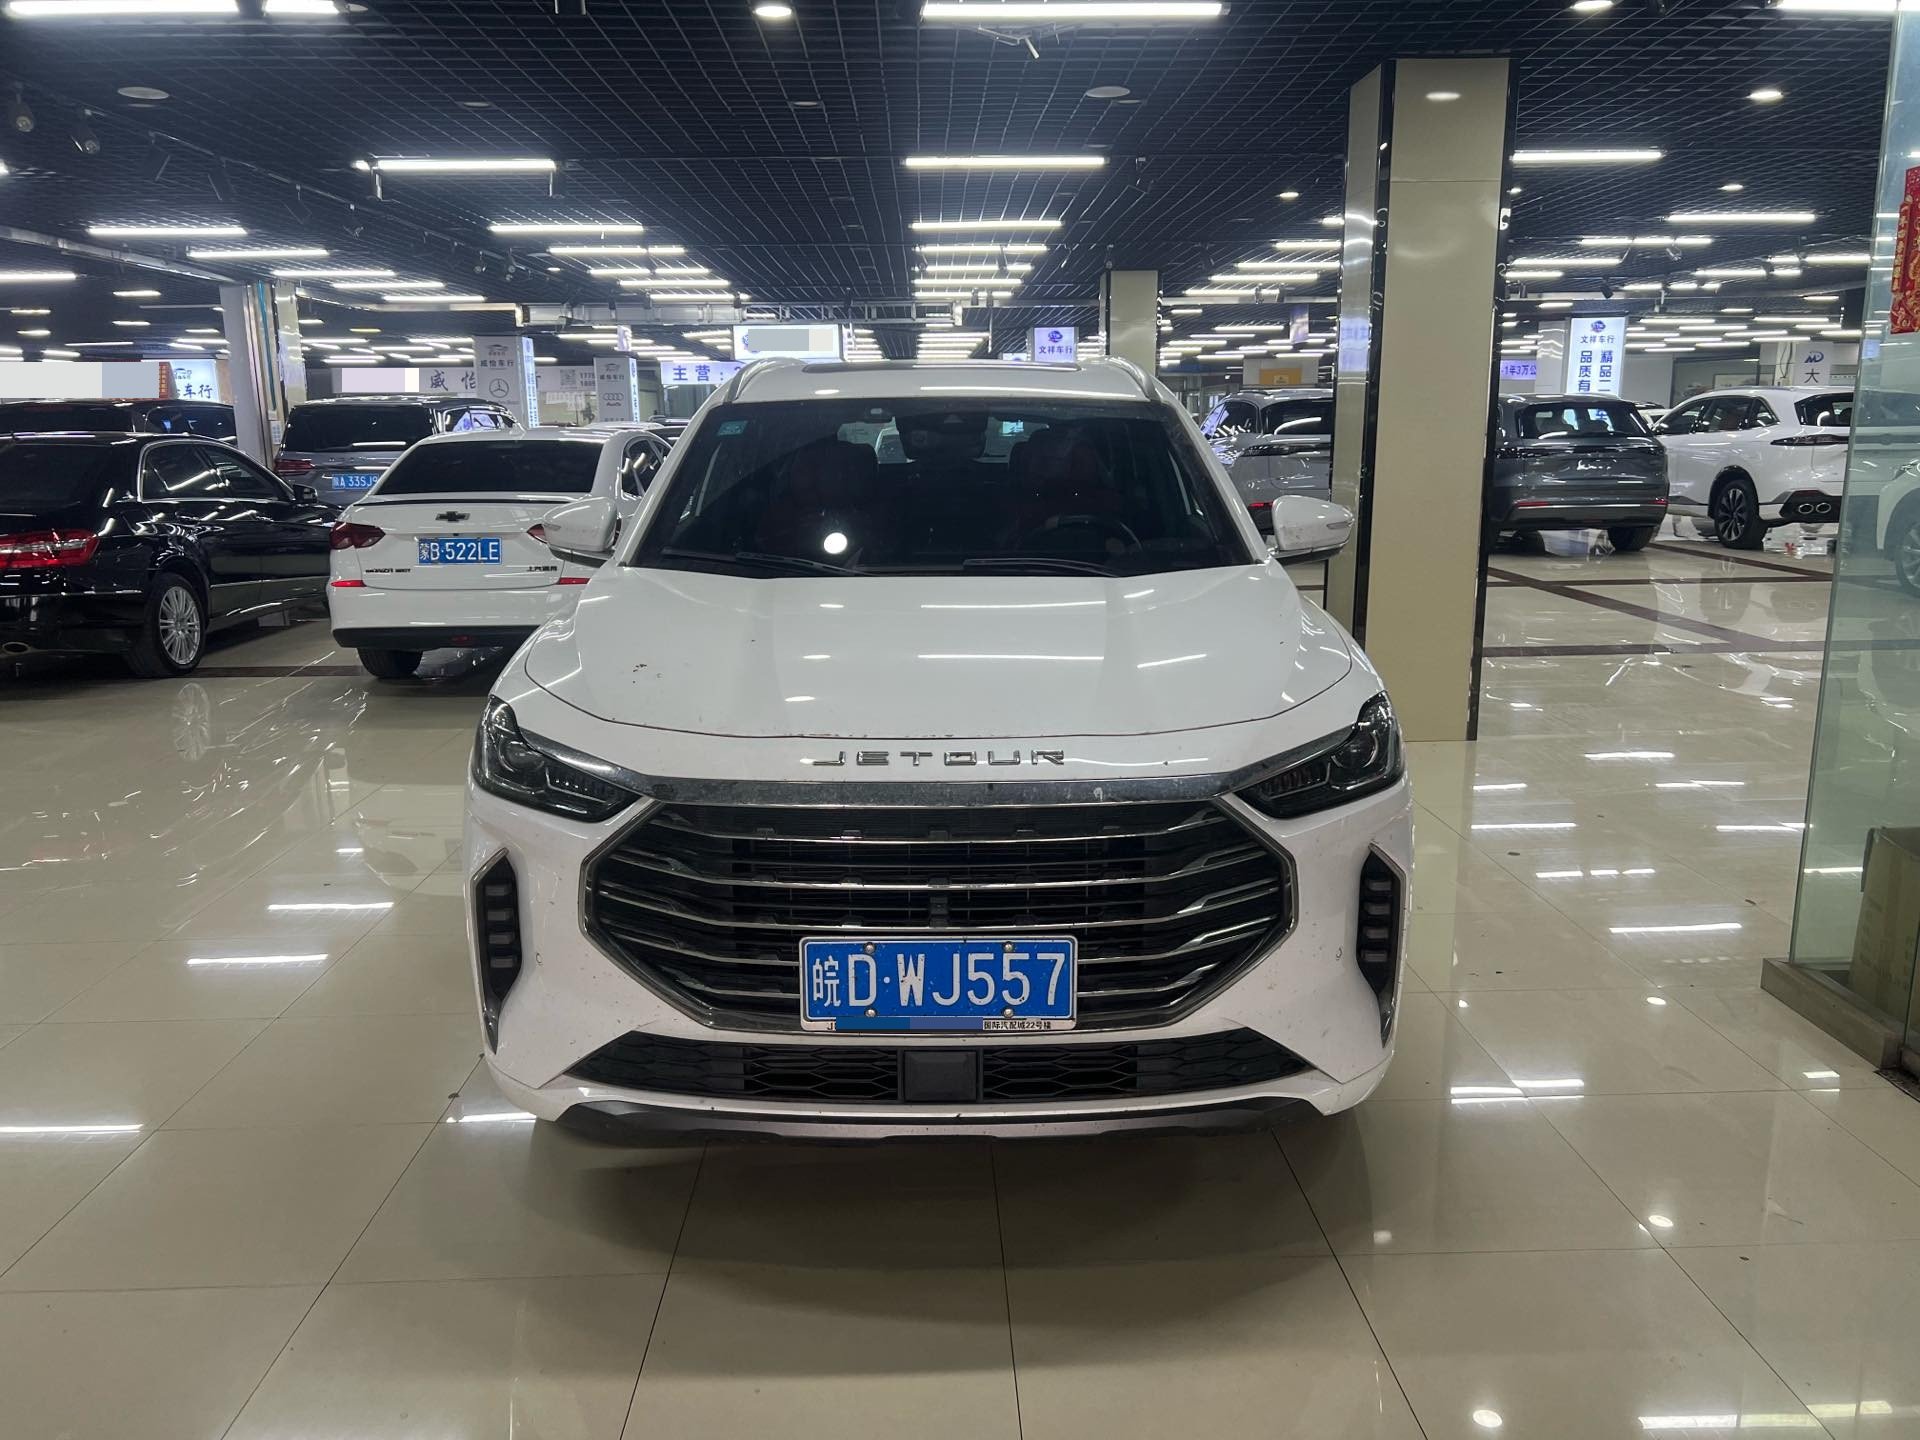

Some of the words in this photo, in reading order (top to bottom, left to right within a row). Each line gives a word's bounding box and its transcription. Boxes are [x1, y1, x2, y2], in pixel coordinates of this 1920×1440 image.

[1580, 335, 1615, 343] 文祥车行
[673, 365, 742, 381] 主营：
[1804, 368, 1820, 384] 大
[177, 383, 212, 399] 车行
[813, 750, 1065, 766] JETOUR
[812, 953, 1066, 1007] 皖D·WJ557
